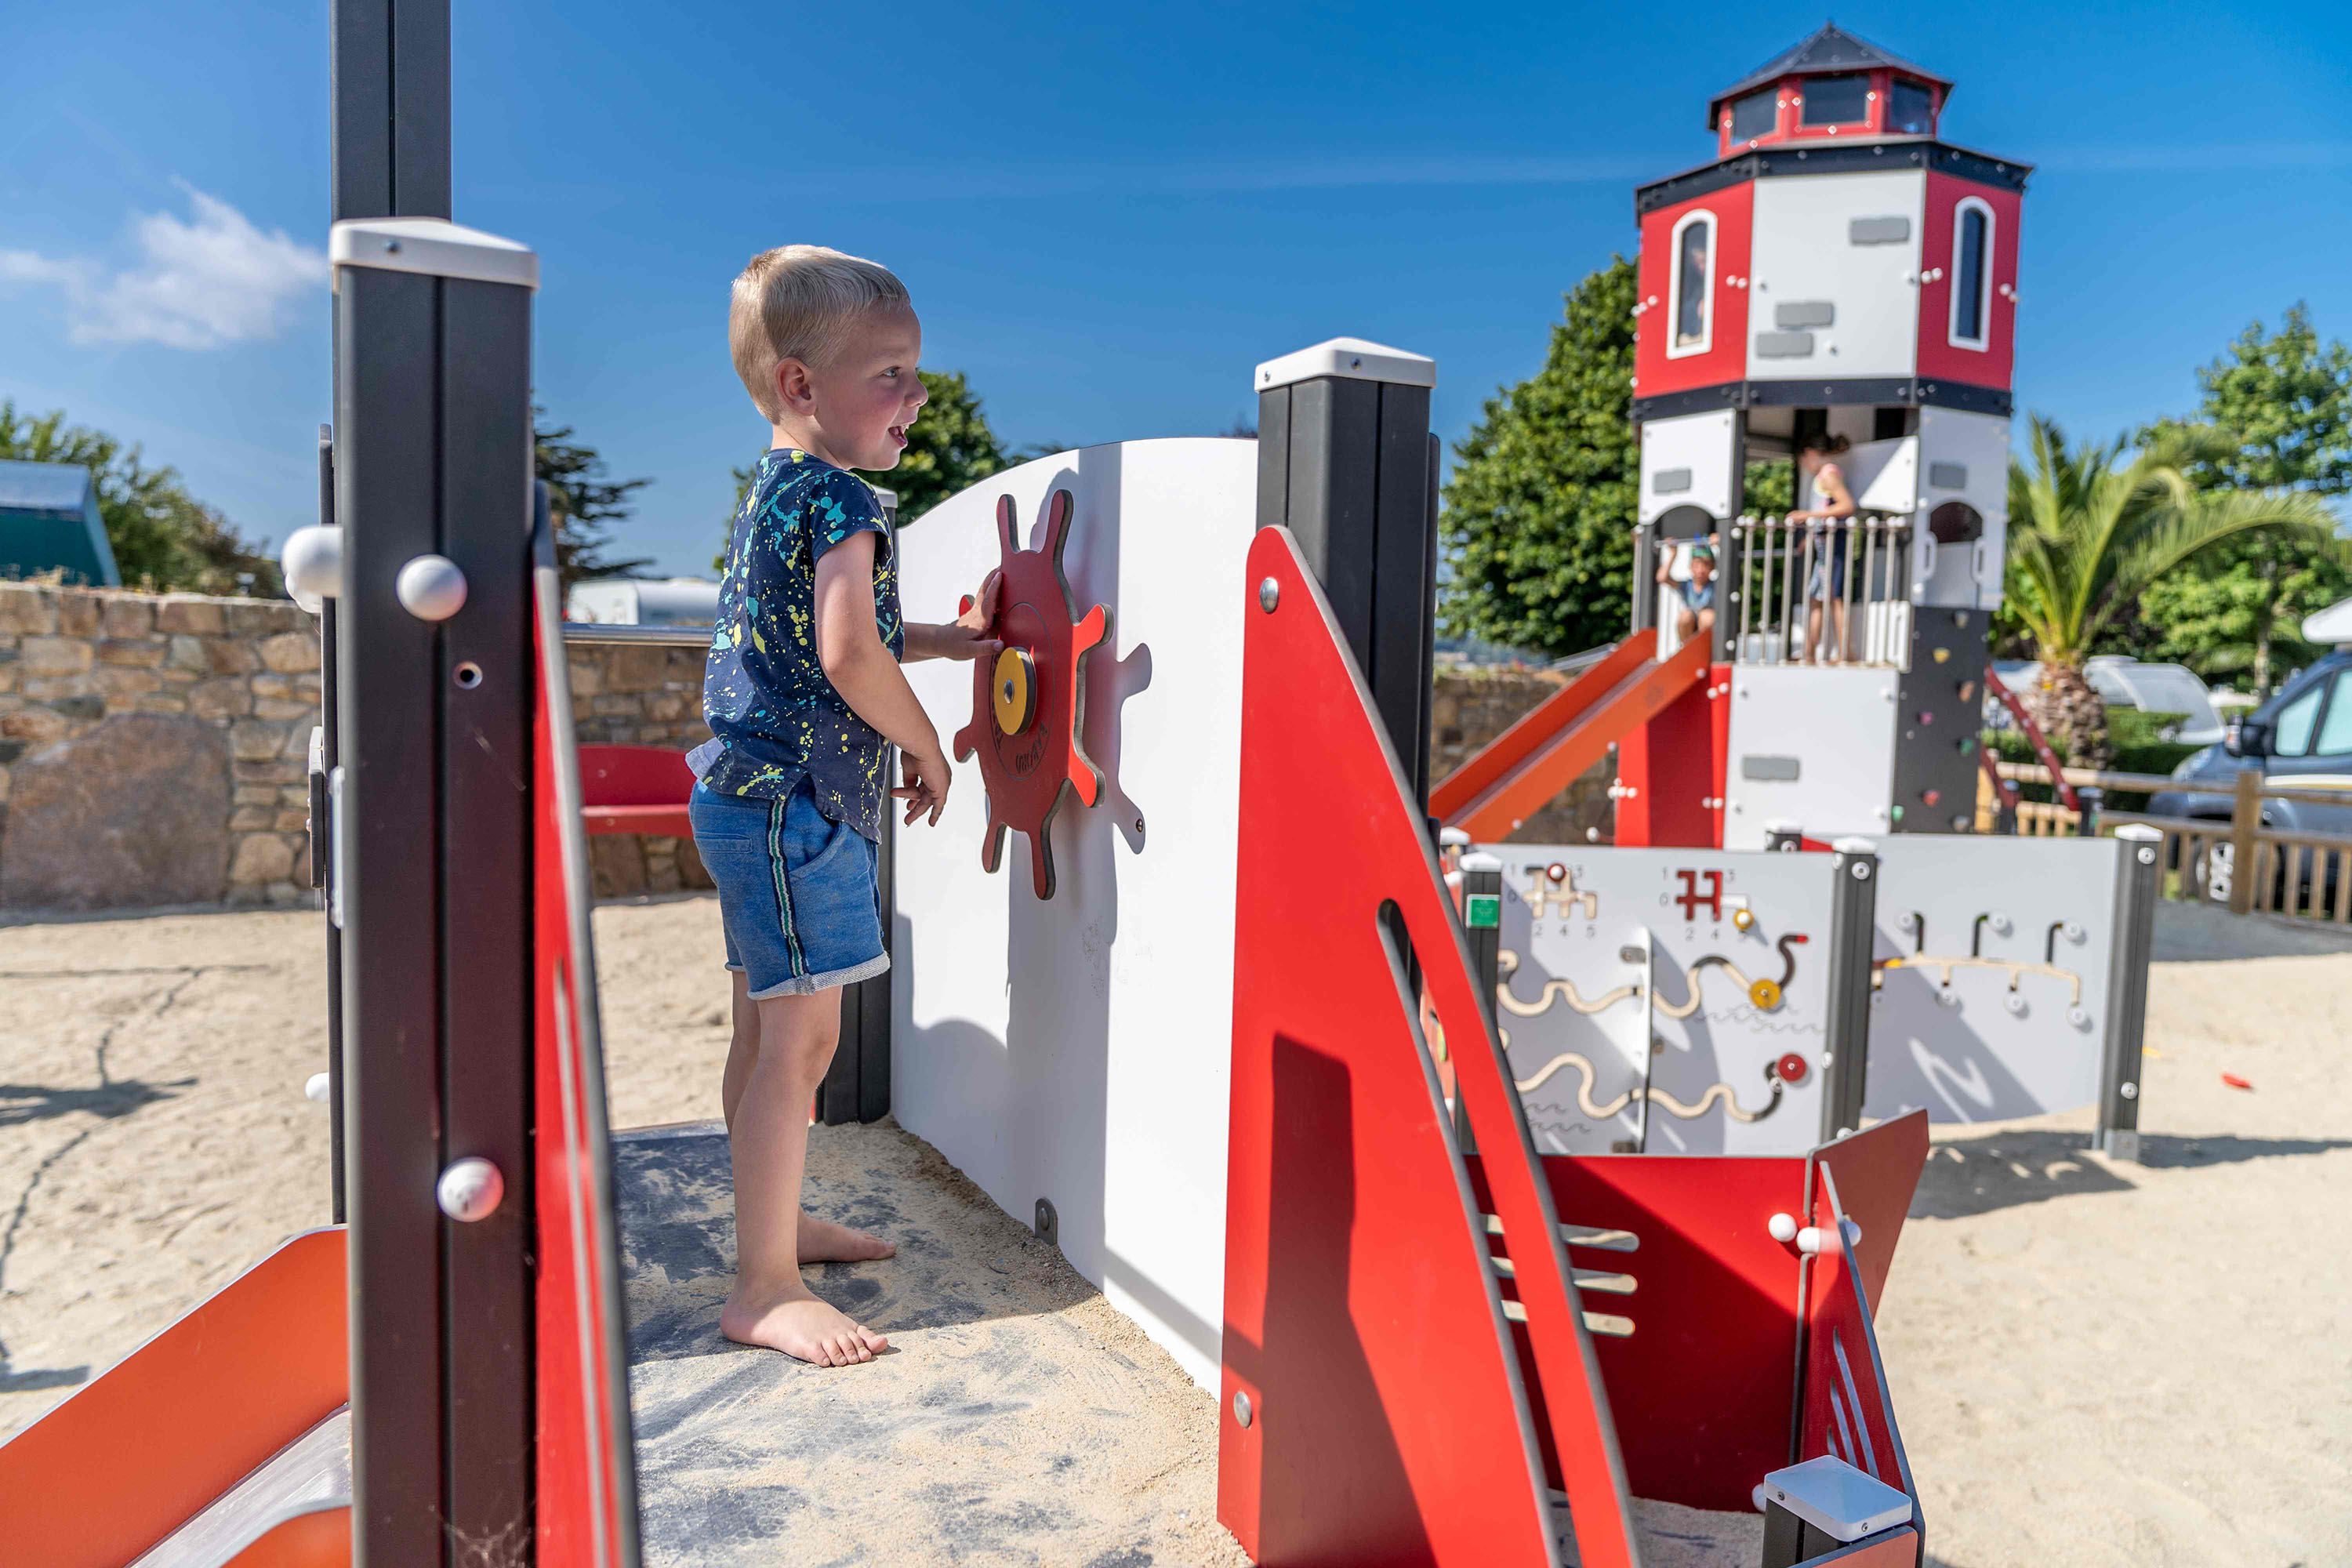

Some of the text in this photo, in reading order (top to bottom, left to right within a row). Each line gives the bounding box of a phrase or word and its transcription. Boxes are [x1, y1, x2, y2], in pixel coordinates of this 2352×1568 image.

[1535, 924, 1543, 936] 2
[1560, 924, 1567, 936] 4
[1686, 927, 1693, 941] 2
[1711, 927, 1719, 940] 4
